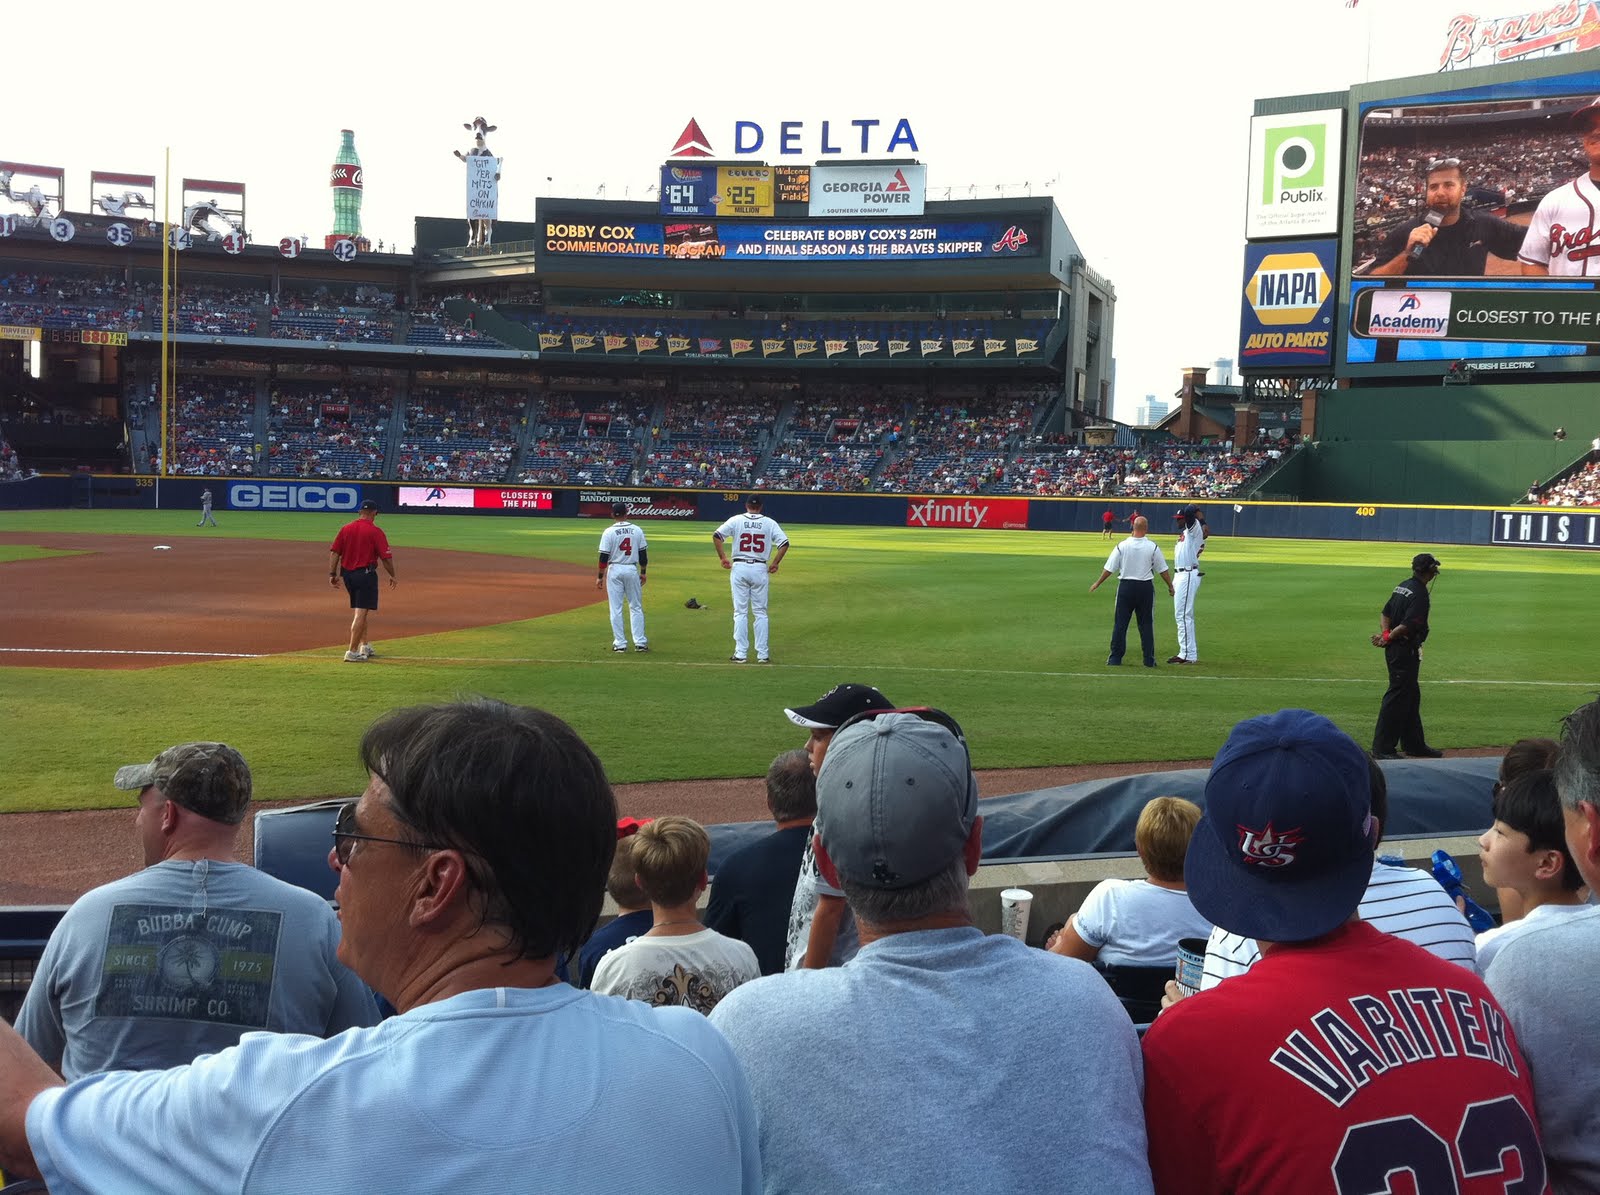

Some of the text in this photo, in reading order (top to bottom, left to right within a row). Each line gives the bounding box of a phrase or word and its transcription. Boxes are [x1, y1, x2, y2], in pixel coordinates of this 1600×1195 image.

[1437, 0, 1579, 72] Braves
[734, 118, 919, 154] DELTA
[476, 169, 490, 179] YER
[775, 167, 809, 175] Welcome
[471, 179, 493, 189] MITS
[788, 175, 796, 183] to
[822, 182, 883, 193] GEORGIA
[477, 190, 490, 199] ON
[781, 193, 802, 201] Field
[863, 193, 910, 203] POWER
[1280, 189, 1324, 204] Publix
[470, 198, 495, 209] CHIKIN
[56, 222, 68, 238] 3
[107, 226, 133, 243] 35
[546, 224, 635, 239] BOBBY COX
[764, 228, 937, 241] CELEBRATE BOBBY COX'S 25TH
[223, 234, 244, 252] 41
[280, 238, 300, 255] 21
[546, 240, 726, 256] COMMEMORATIVE PROGRAM
[736, 241, 983, 255] AND FINAL SEASON AS THE BRAVES SKIPPER
[335, 242, 355, 259] 42
[1259, 272, 1317, 306] NAPA
[1456, 310, 1529, 324] CLOSEST
[1533, 311, 1555, 325] TO
[1559, 312, 1592, 325] THE
[1370, 314, 1445, 333] Academy
[83, 331, 109, 343] 680
[573, 338, 589, 346] 1982
[606, 338, 621, 347] 1991
[1245, 331, 1329, 349] AUTO PARTS
[638, 339, 653, 348] 1992
[669, 340, 685, 349] 1993
[764, 342, 780, 350] 1997
[826, 342, 843, 350] 1999
[859, 342, 873, 350] 2000
[890, 342, 904, 350] 2001
[922, 342, 937, 350] 2002
[954, 342, 969, 350] 2003
[986, 342, 1001, 350] 2004
[1017, 342, 1033, 350] 2005
[1500, 361, 1535, 369] ELECTRIC
[135, 478, 154, 487] 335
[230, 484, 358, 509] GEICO
[501, 491, 553, 500] CLOSEST TO
[580, 495, 651, 503] BANDOFBUDS.COM
[723, 493, 739, 502] 380
[522, 500, 537, 508] PIN
[625, 502, 694, 517] Budweiser
[910, 499, 988, 528] xfinity
[1355, 507, 1375, 517] 400
[743, 521, 763, 530] GLAUS
[1501, 514, 1570, 542] THIS
[615, 528, 635, 536] INFANTE
[619, 537, 632, 556] 4
[739, 532, 766, 553] 25
[138, 914, 252, 938] BUBBA GUMP
[113, 953, 262, 973] SINCE 1975
[133, 995, 231, 1016] SHRIMP CO.
[1269, 987, 1519, 1108] VARITEK
